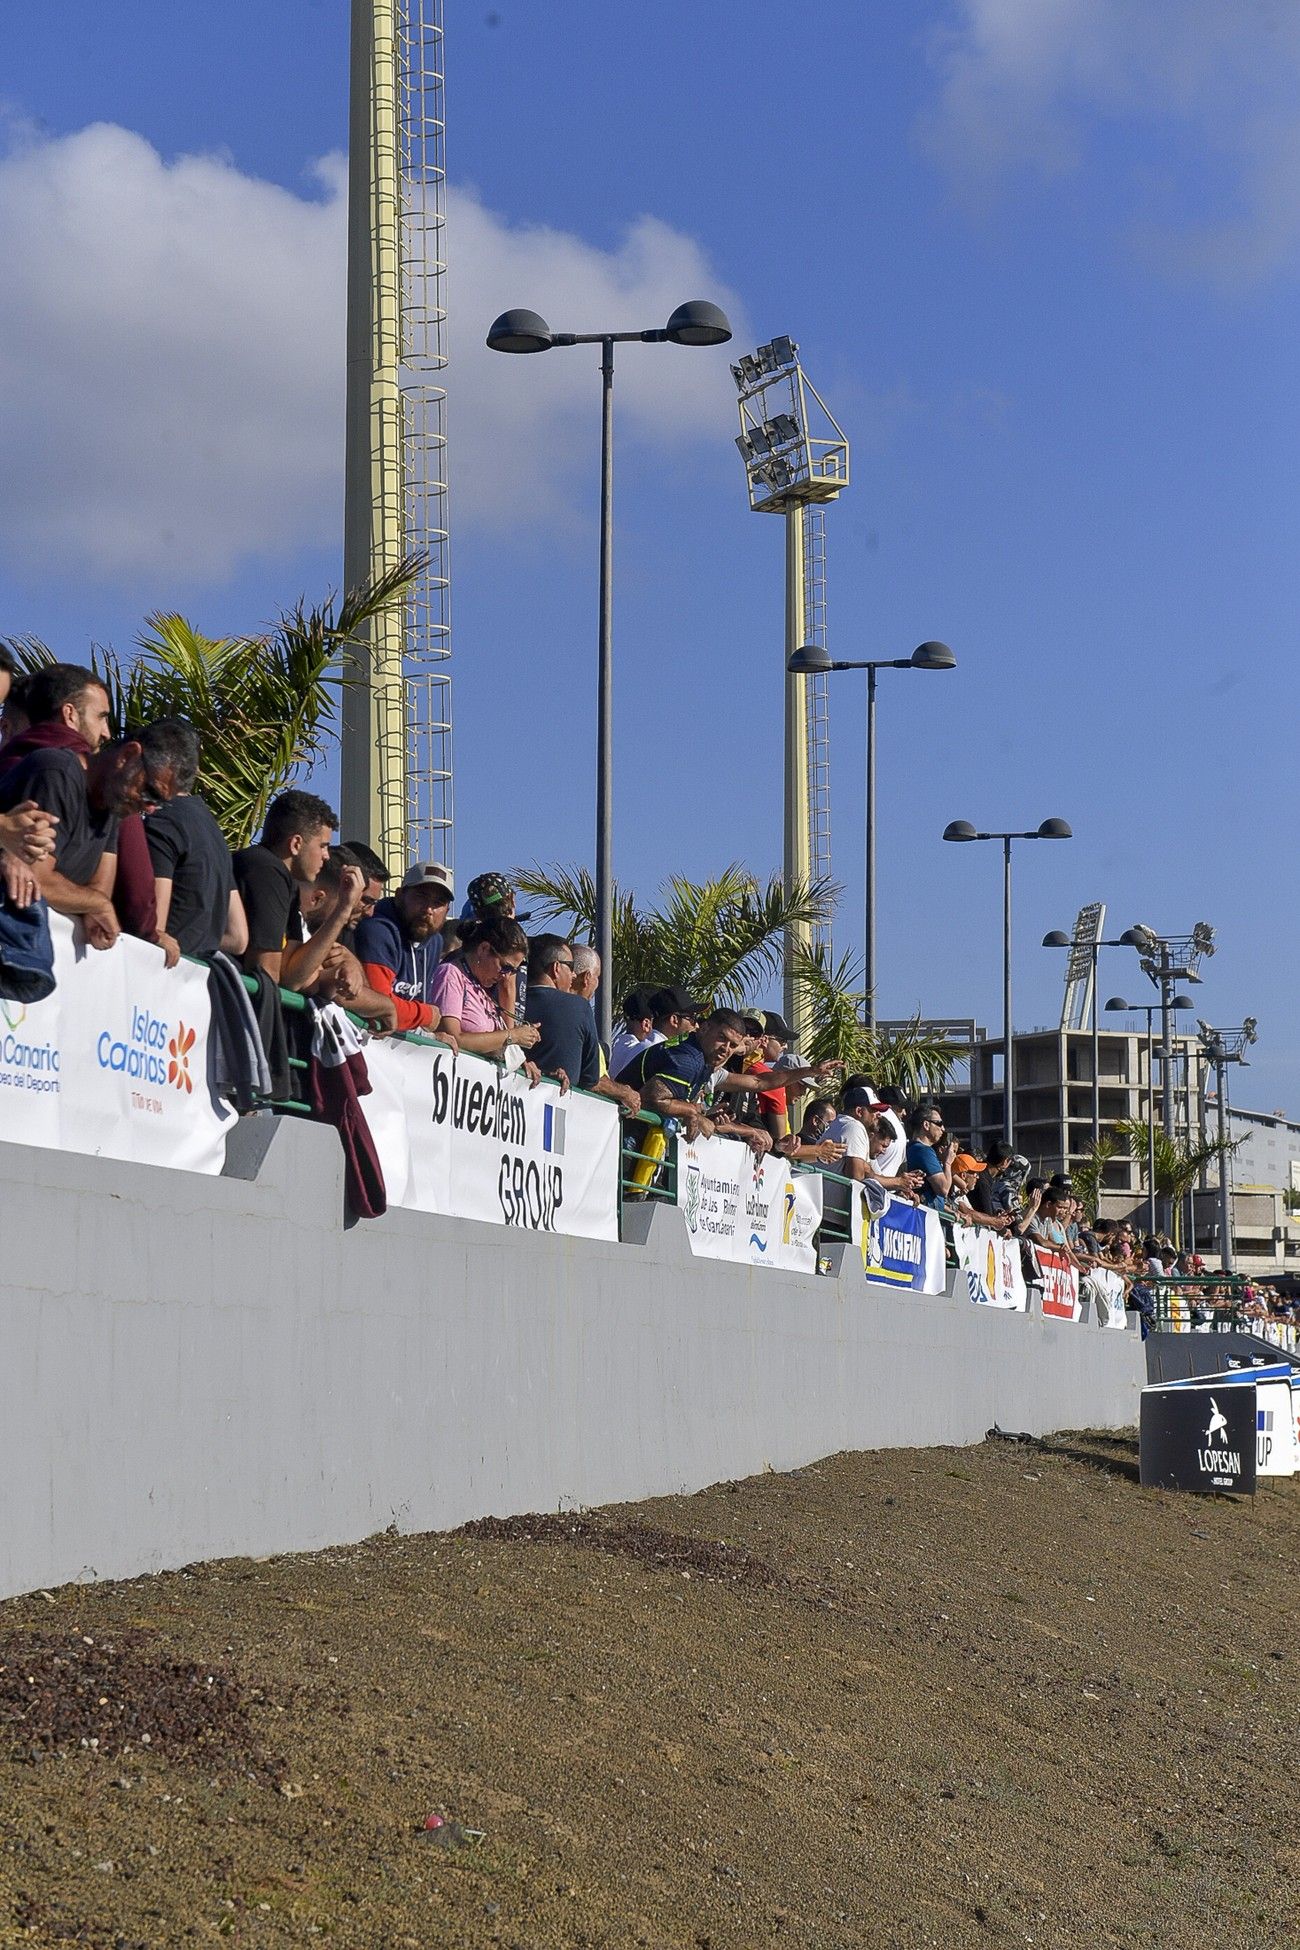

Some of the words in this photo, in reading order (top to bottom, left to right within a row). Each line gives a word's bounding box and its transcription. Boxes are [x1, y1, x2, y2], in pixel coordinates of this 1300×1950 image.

[132, 1005, 168, 1050] Islas
[432, 1054, 526, 1146] bluechem
[498, 1153, 563, 1232] GROUP
[1198, 1449, 1241, 1475] LOPESAN
